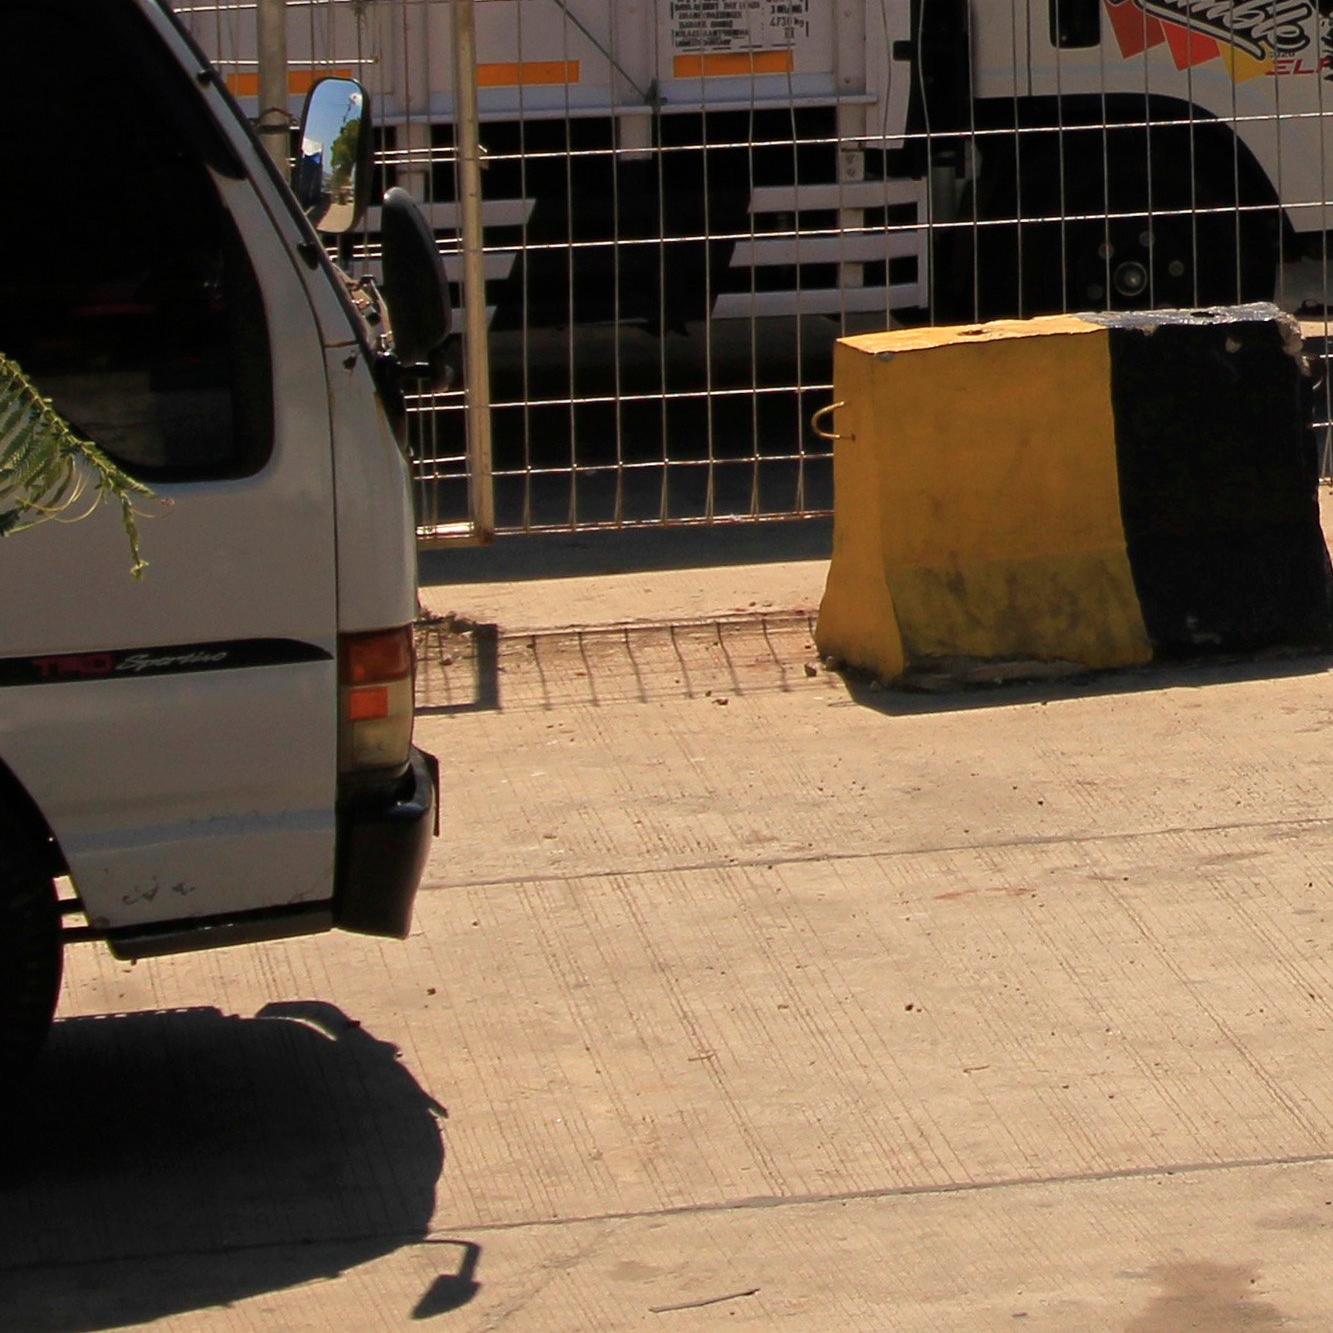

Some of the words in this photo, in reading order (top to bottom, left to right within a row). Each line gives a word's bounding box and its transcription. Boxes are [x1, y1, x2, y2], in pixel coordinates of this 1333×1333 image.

[1265, 57, 1330, 76] ELF
[31, 652, 114, 681] TRD
[115, 650, 229, 673] Sportivo
